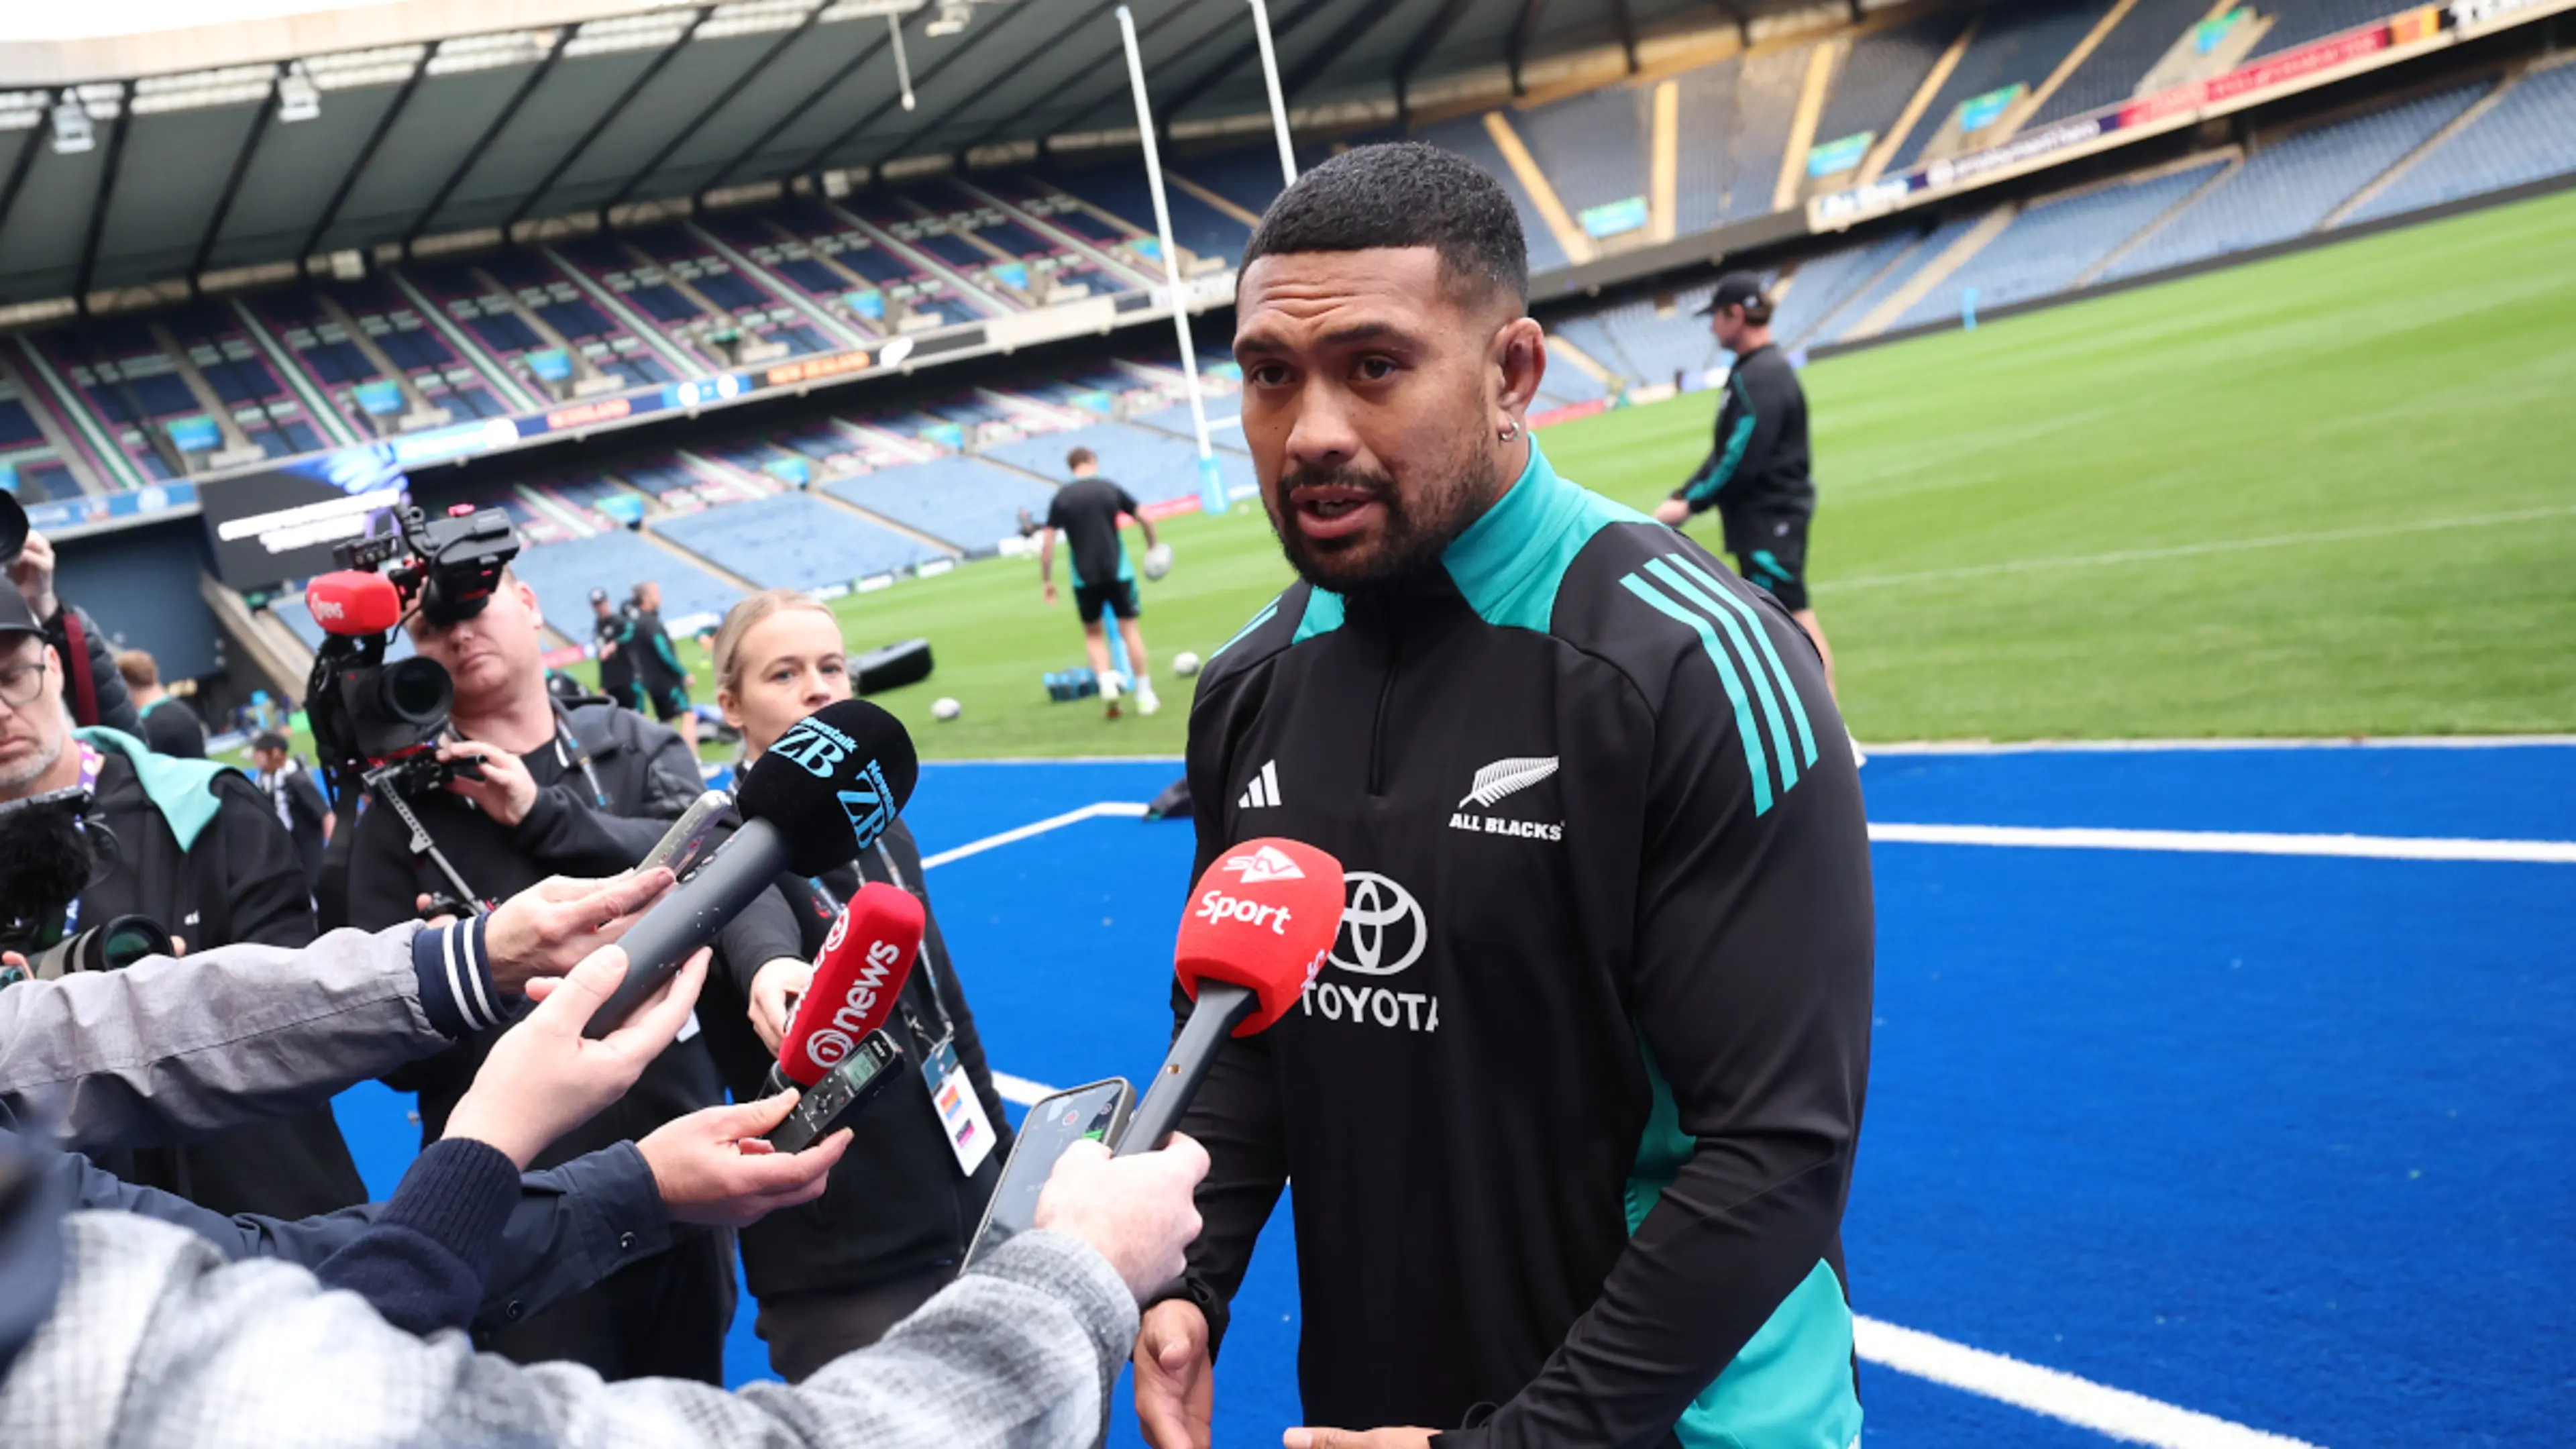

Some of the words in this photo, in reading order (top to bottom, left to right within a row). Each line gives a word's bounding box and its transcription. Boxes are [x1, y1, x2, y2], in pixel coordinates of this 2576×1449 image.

[768, 724, 845, 778] ZB
[837, 769, 885, 849] ZB
[1448, 813, 1481, 831] ALL
[1485, 817, 1562, 841] BLACKS
[1195, 890, 1292, 935] Sport
[1301, 981, 1439, 1033] TOYOTA
